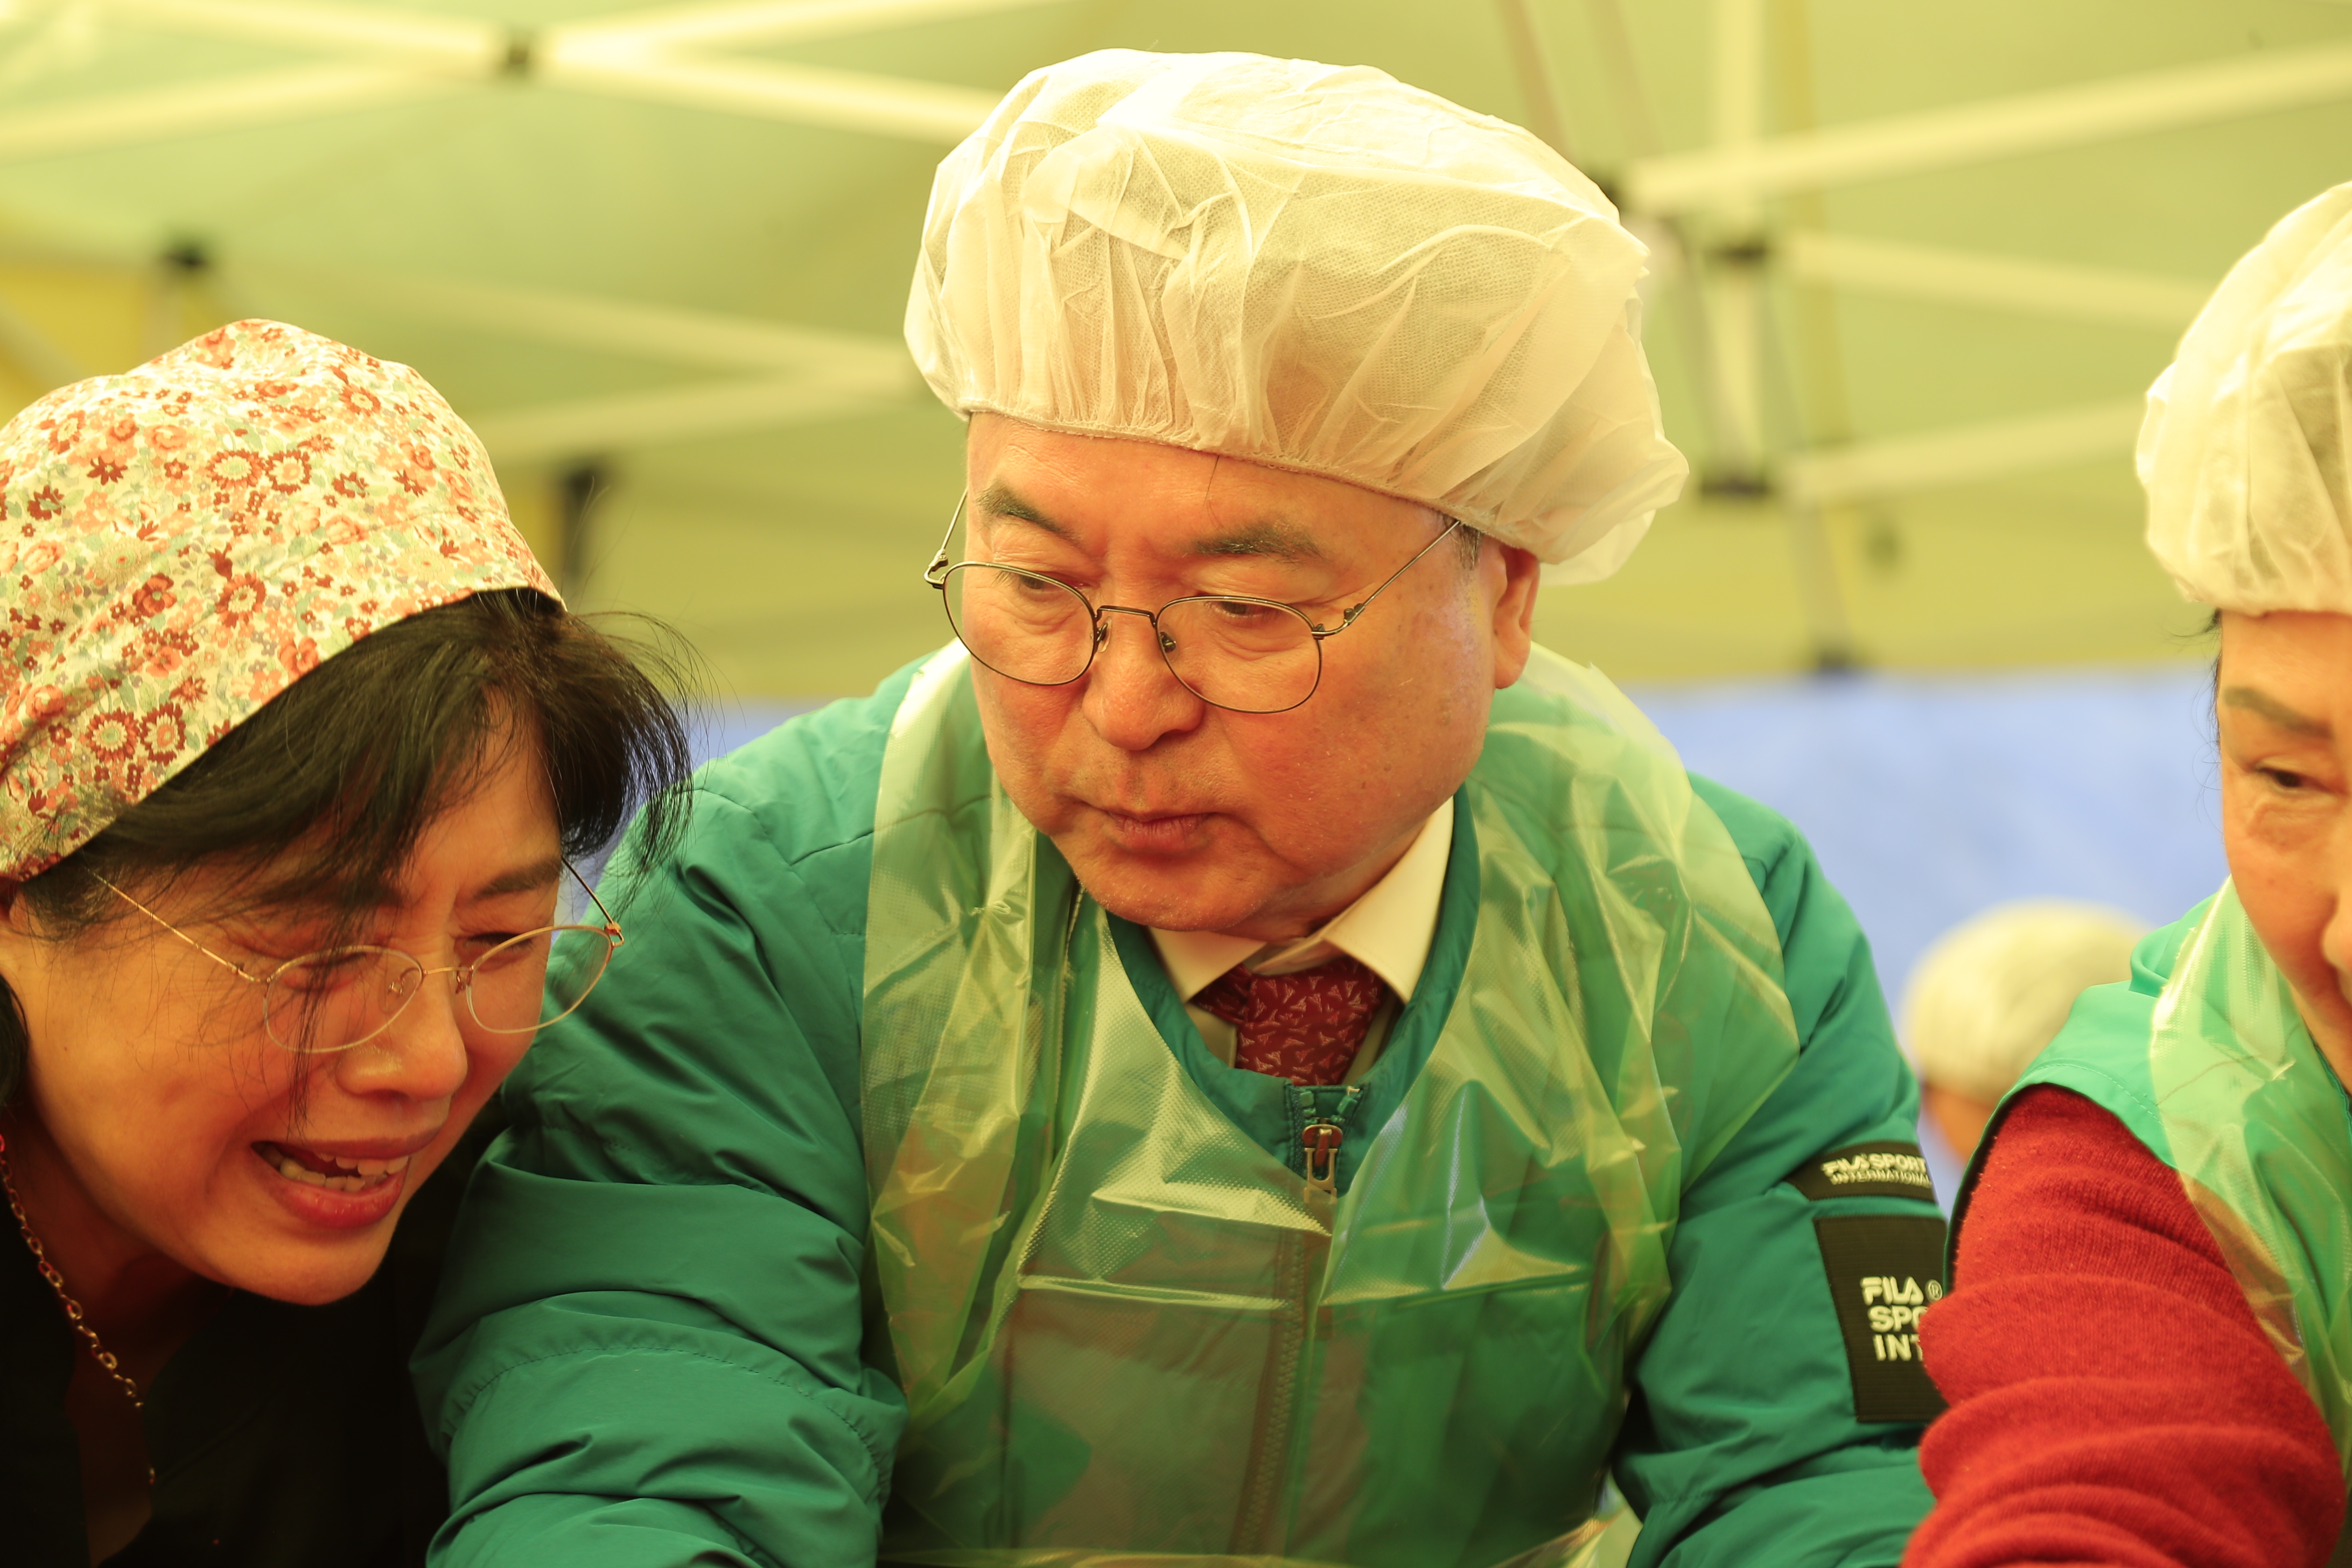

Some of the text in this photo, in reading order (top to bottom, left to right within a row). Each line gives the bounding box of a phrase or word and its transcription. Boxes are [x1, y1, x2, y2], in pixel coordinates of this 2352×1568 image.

[1821, 1152, 1927, 1177] FILA SPORT
[1860, 1276, 1924, 1306] FILA
